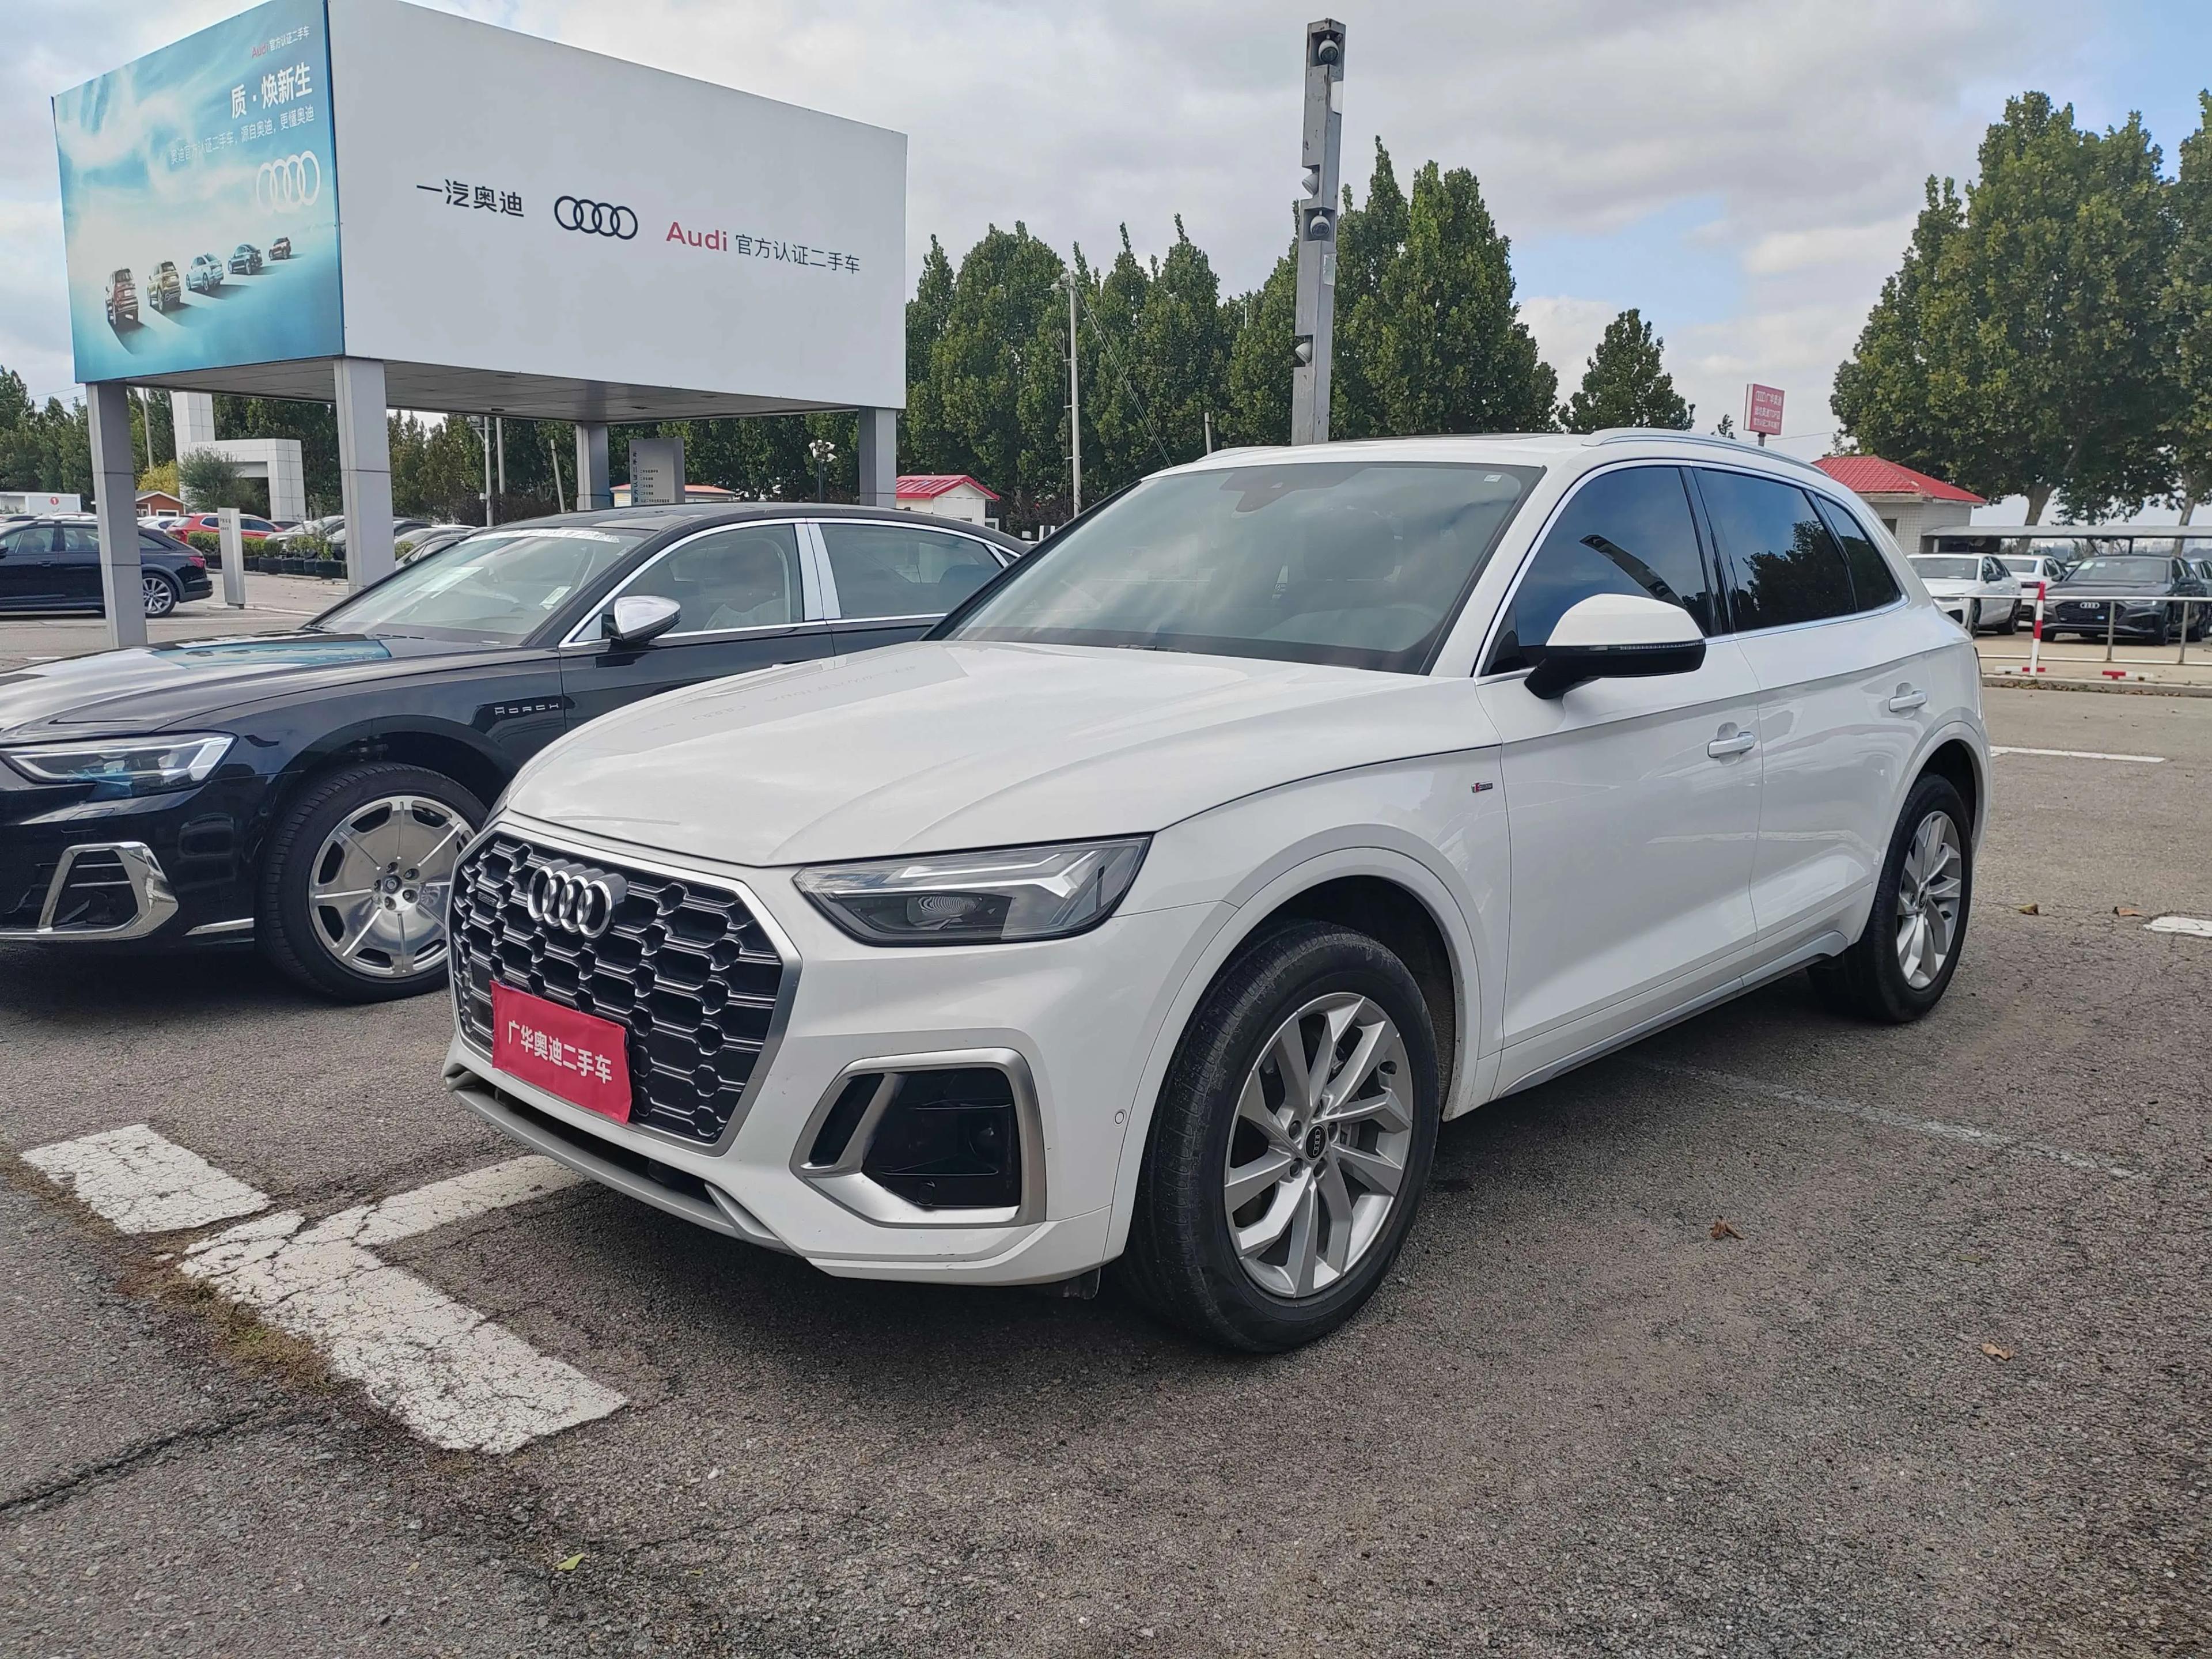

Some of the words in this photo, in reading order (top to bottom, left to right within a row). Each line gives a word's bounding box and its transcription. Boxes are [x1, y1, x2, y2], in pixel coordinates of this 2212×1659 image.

[252, 42, 268, 58] Audi
[269, 25, 309, 51] 官方认证二手车
[416, 179, 524, 217] 一汽奥迪
[666, 221, 727, 252] Audi
[736, 234, 860, 274] 官方认证二手车
[494, 703, 559, 715] HORCH
[507, 1020, 613, 1084] 广华奥迪二手车
